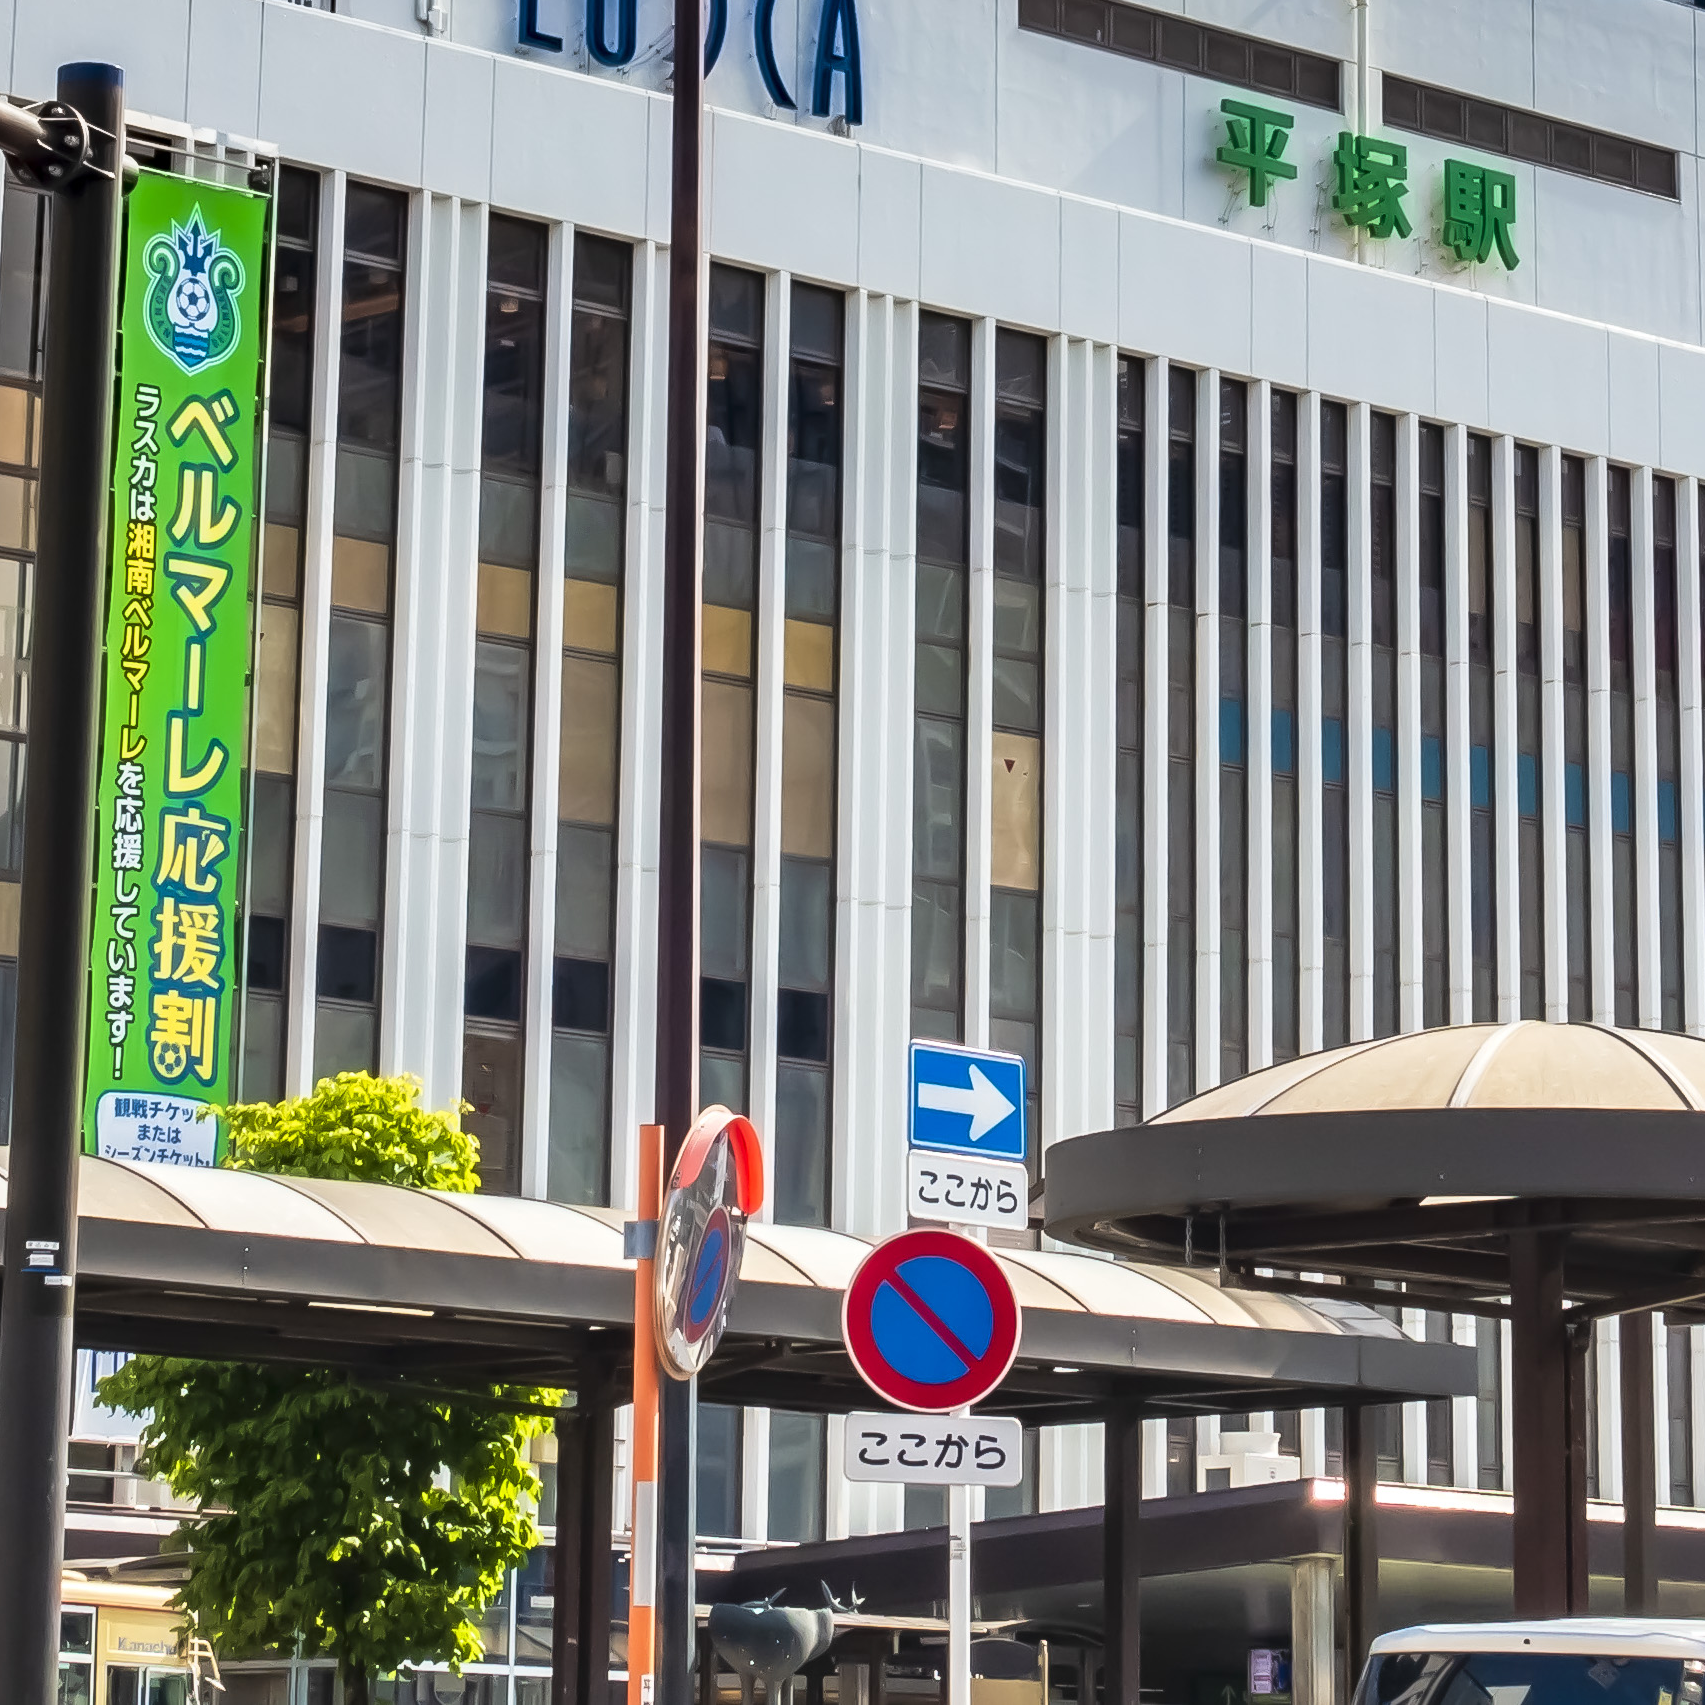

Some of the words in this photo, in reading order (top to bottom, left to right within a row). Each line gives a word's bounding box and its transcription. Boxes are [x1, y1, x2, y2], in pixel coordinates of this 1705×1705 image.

[1216, 98, 1520, 271] 平塚駅
[150, 390, 240, 1086] ベルマーレ応援割
[114, 1097, 202, 1124] 観戦チケッ
[137, 1124, 182, 1143] または
[918, 1169, 1018, 1212] ここから
[858, 1431, 1007, 1470] ここから
